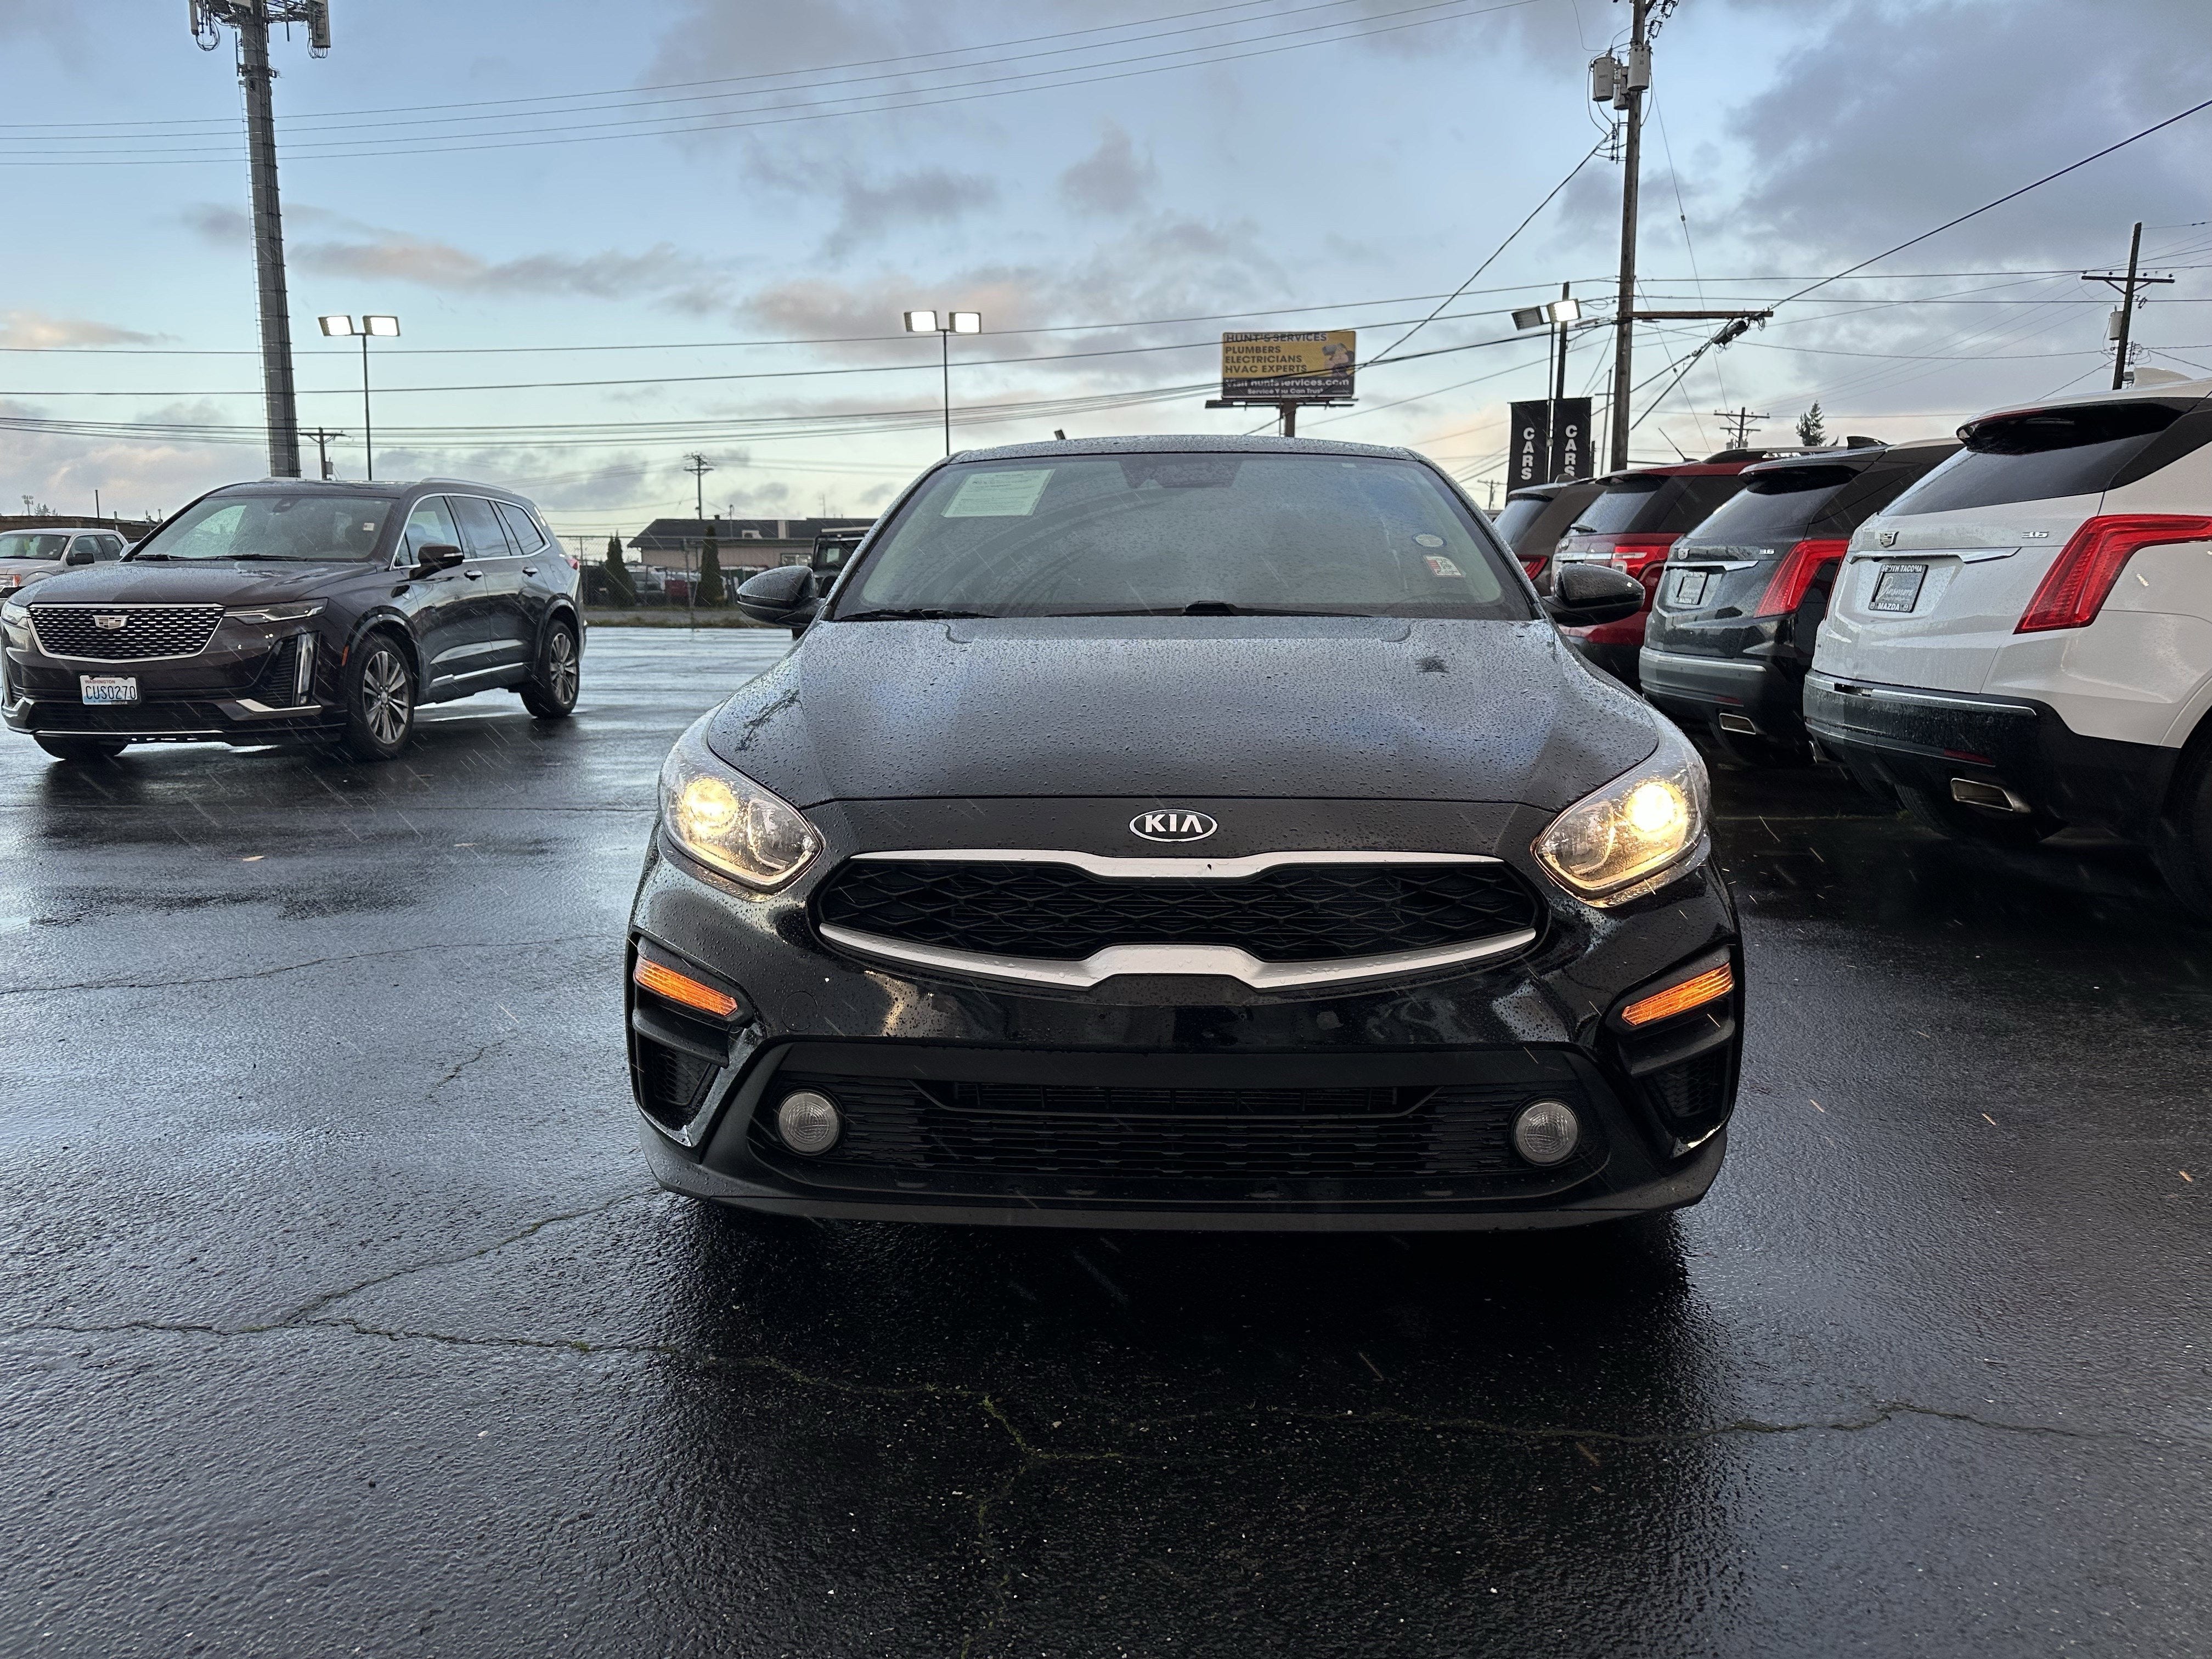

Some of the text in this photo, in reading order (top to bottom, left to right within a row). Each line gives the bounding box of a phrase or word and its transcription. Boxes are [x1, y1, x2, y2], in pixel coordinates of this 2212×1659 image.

[1273, 332, 1327, 342] SERVICES
[1225, 346, 1282, 354] PLUMBERS
[1225, 356, 1302, 364] ELECTRICIANS
[1225, 364, 1308, 373] HVAC EXPERTS
[1521, 427, 1535, 480] CARS
[1564, 425, 1577, 477] CARS
[1877, 602, 1900, 611] MAZDA
[1144, 814, 1203, 833] KIA
